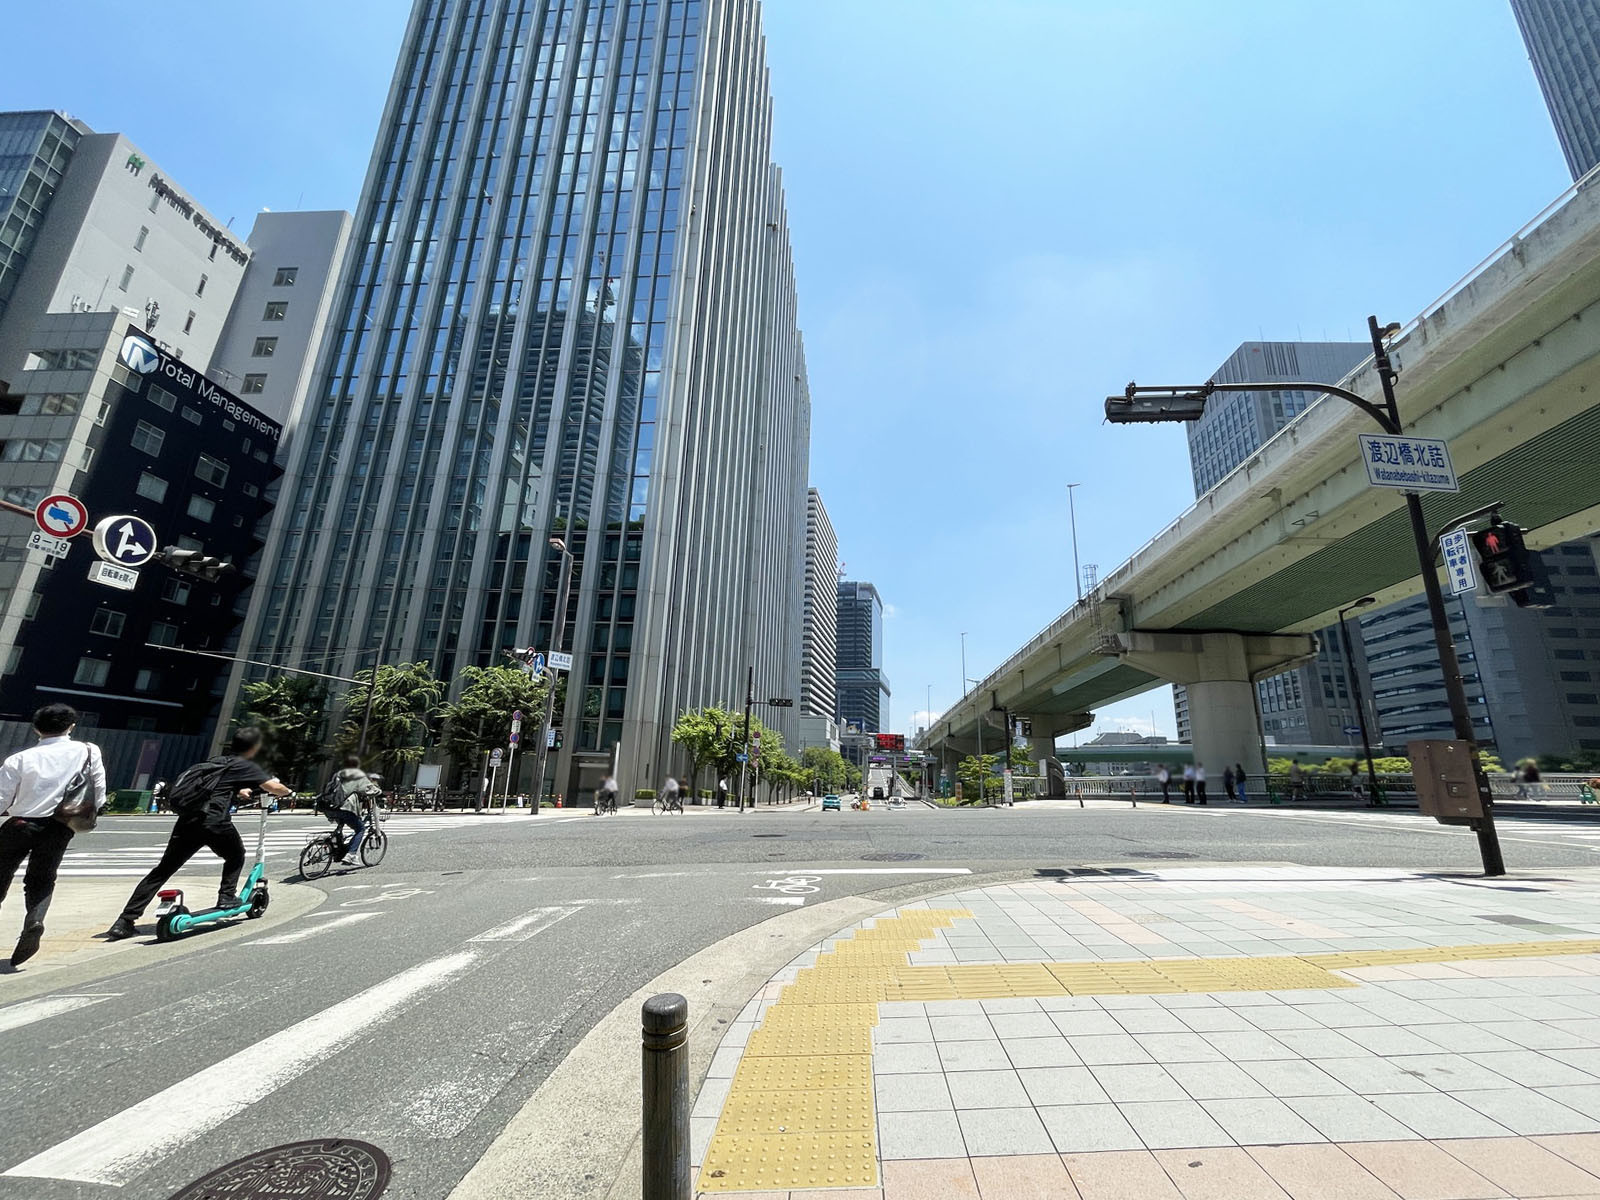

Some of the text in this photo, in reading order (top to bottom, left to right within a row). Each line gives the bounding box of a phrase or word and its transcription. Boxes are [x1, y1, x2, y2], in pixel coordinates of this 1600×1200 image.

[160, 353, 280, 441] Total Management
[1367, 440, 1445, 468] 渡辺橋北詰
